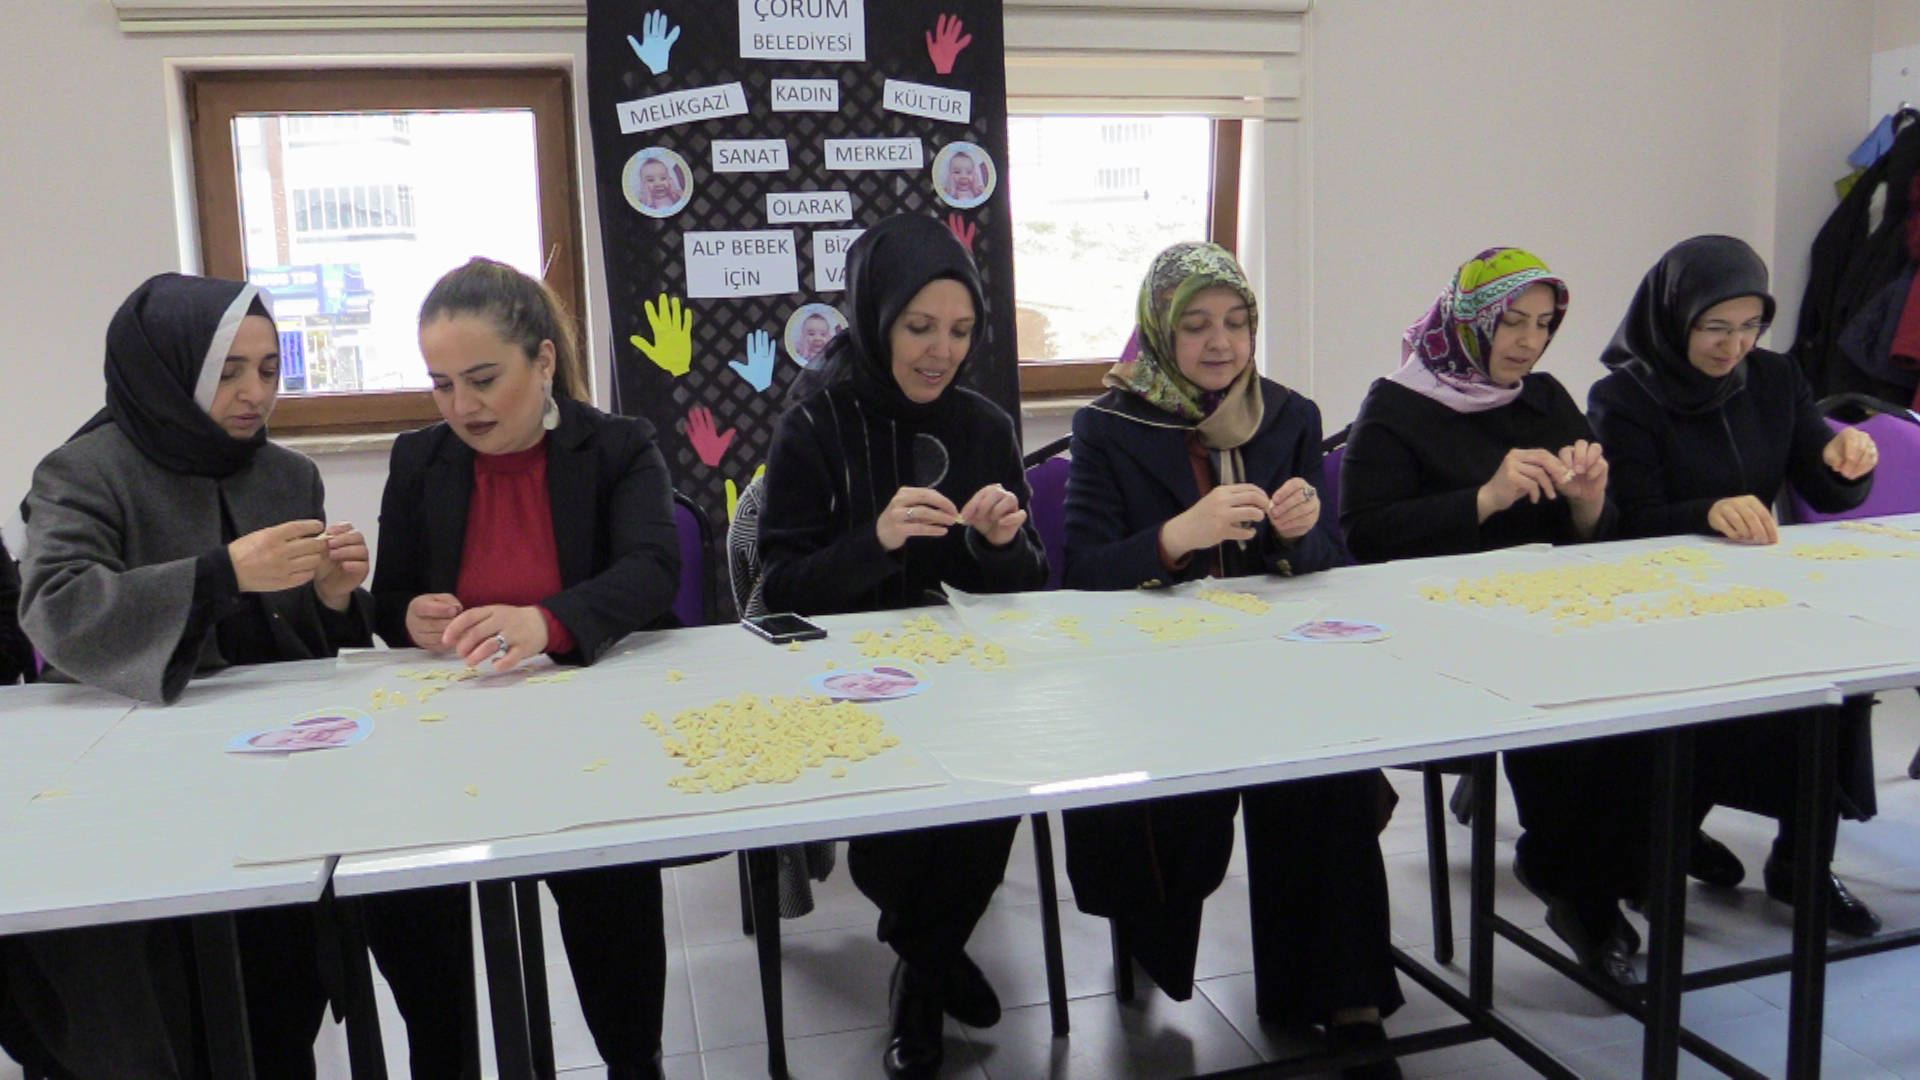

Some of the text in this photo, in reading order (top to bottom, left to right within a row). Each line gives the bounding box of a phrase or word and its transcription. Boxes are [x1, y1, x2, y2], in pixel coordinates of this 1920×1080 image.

[753, 0, 848, 22] ÇORUM
[753, 32, 852, 52] BELEDİYESİ
[775, 85, 832, 102] KADIN
[893, 89, 963, 116] KÜLTÜR
[630, 89, 731, 126] MELİKGAZİ
[719, 148, 781, 165] SANAT
[835, 143, 913, 163] MERKEZİ
[772, 198, 846, 217] OLARAK
[692, 238, 790, 256] ALP BEBEK
[723, 267, 761, 290] İÇİN
